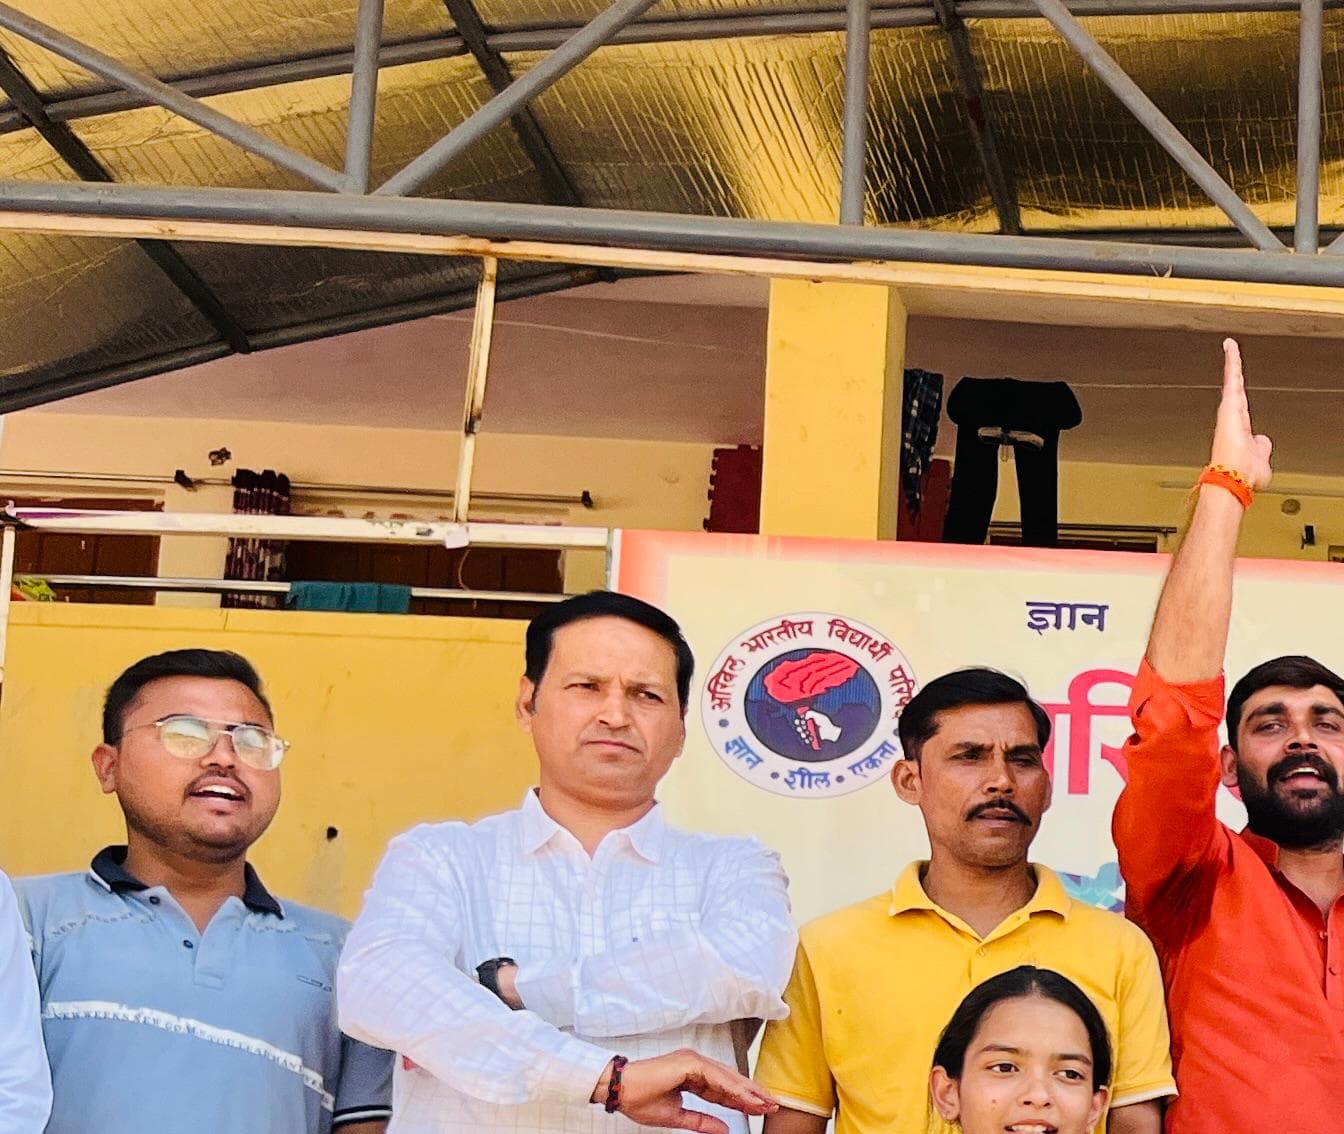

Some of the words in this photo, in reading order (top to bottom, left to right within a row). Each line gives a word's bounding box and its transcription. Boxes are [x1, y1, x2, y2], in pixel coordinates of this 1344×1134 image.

[1026, 600, 1109, 634] ज्ञान
[707, 655, 747, 713] अखिल
[741, 619, 814, 654] भारतीय
[828, 619, 895, 663] विद्यार्थी
[724, 735, 764, 770] ज्ञान
[784, 766, 831, 790] शील
[847, 740, 898, 778] एकता
